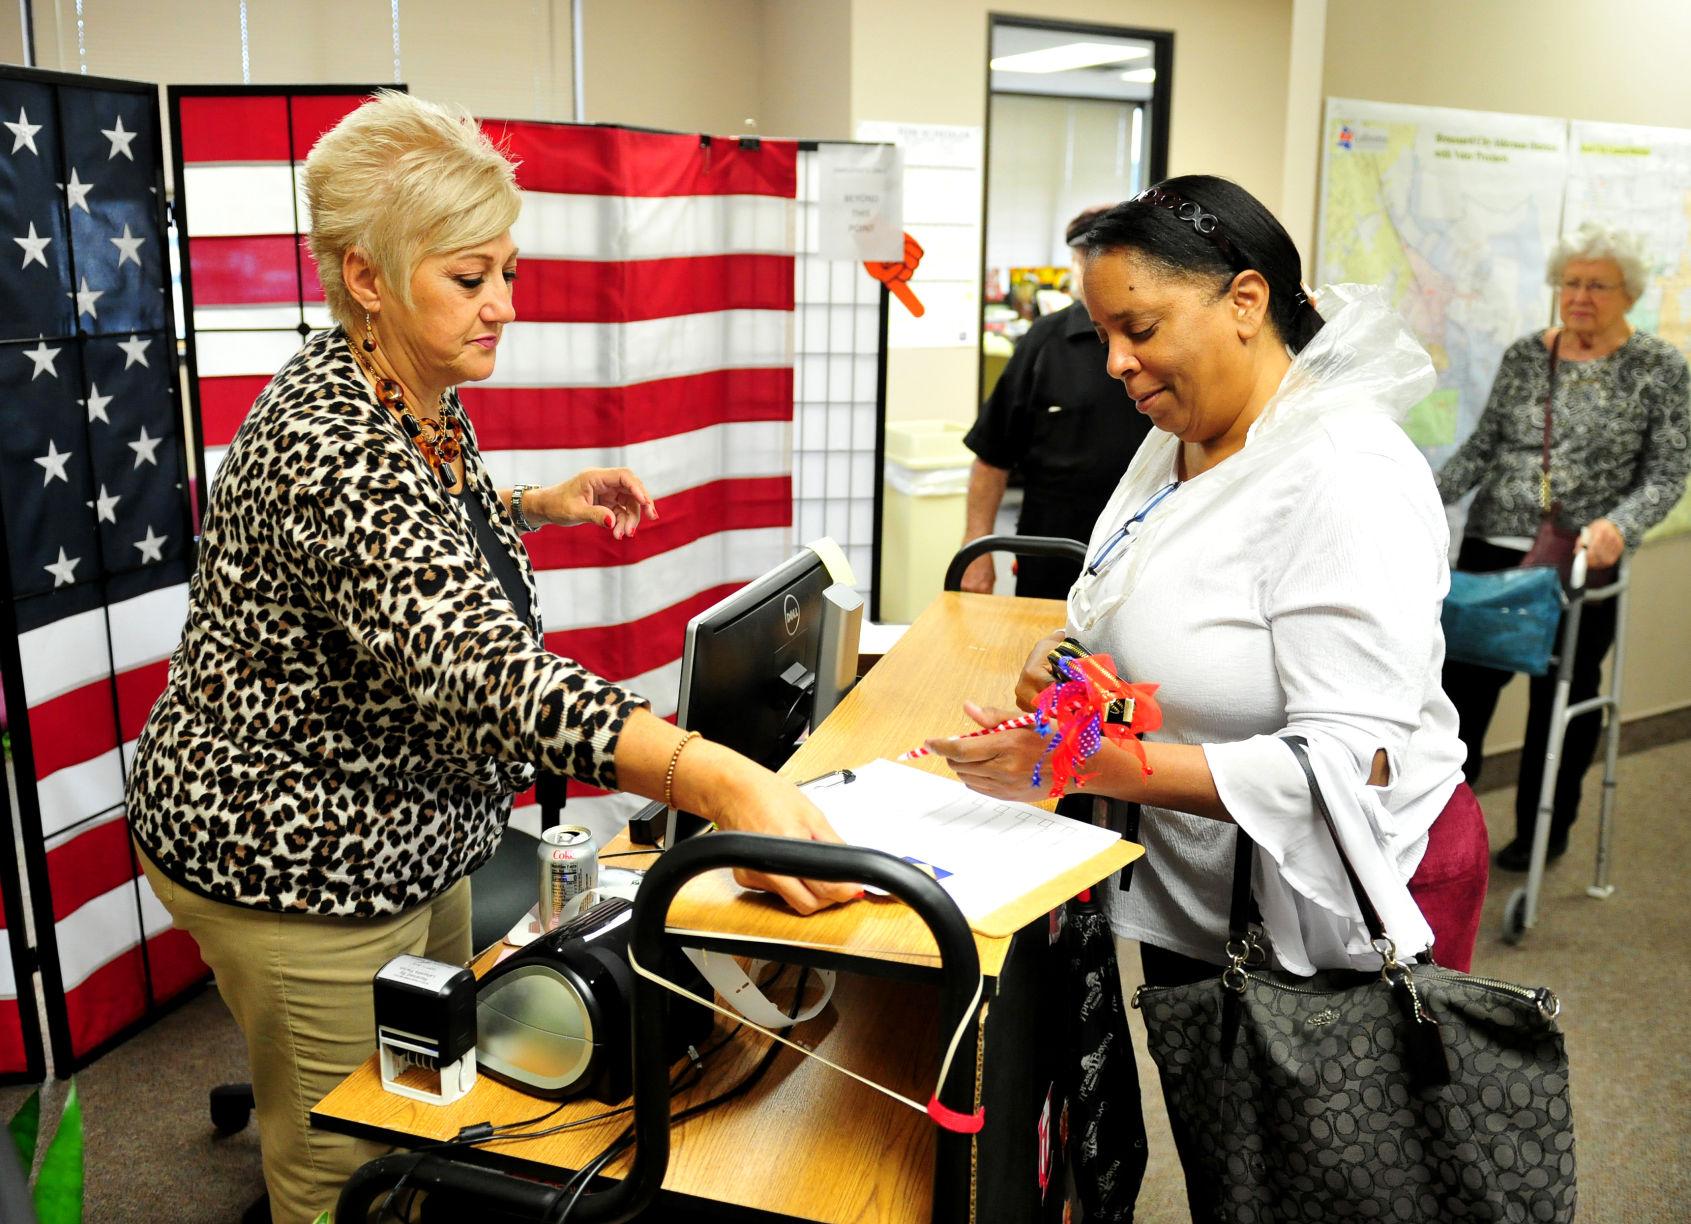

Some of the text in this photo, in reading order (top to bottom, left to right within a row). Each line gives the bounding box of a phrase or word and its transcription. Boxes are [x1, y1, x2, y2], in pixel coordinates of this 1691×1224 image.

[844, 194, 879, 203] BEYOND
[848, 224, 874, 233] POINT
[1093, 1032, 1114, 1062] Bayou
